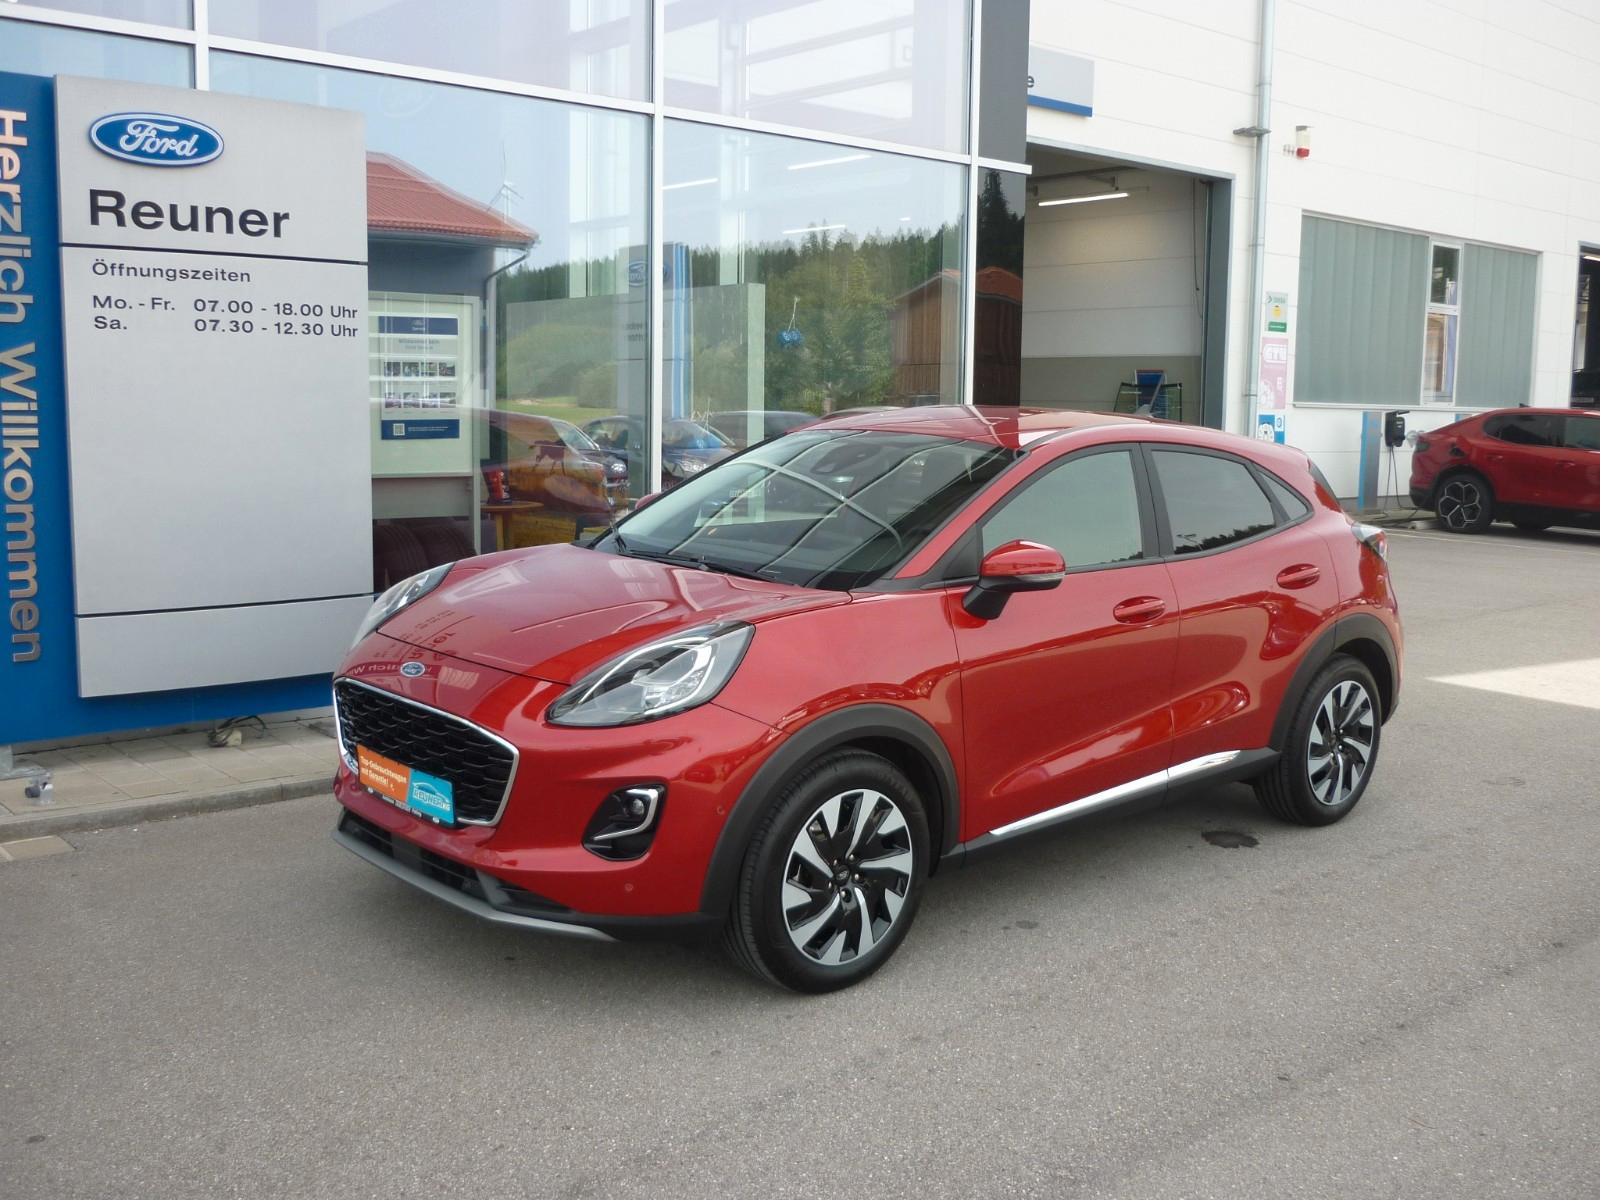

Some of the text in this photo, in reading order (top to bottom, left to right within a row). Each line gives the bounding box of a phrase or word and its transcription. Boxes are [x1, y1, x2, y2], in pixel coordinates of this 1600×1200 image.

[120, 120, 200, 157] Ford
[90, 189, 290, 238] Reuner
[92, 259, 251, 283] Öffnungszeiten
[93, 296, 133, 310] Mo.
[152, 298, 176, 311] Fr.
[194, 299, 253, 314] 07.00
[274, 303, 324, 317] 18.00
[331, 305, 358, 318] Uhr
[94, 316, 128, 330] Sa.
[195, 319, 254, 333] 07.30
[274, 323, 324, 336] 12.30
[331, 325, 358, 337] Uhr
[0, 109, 42, 662] Herzlich Willkommen
